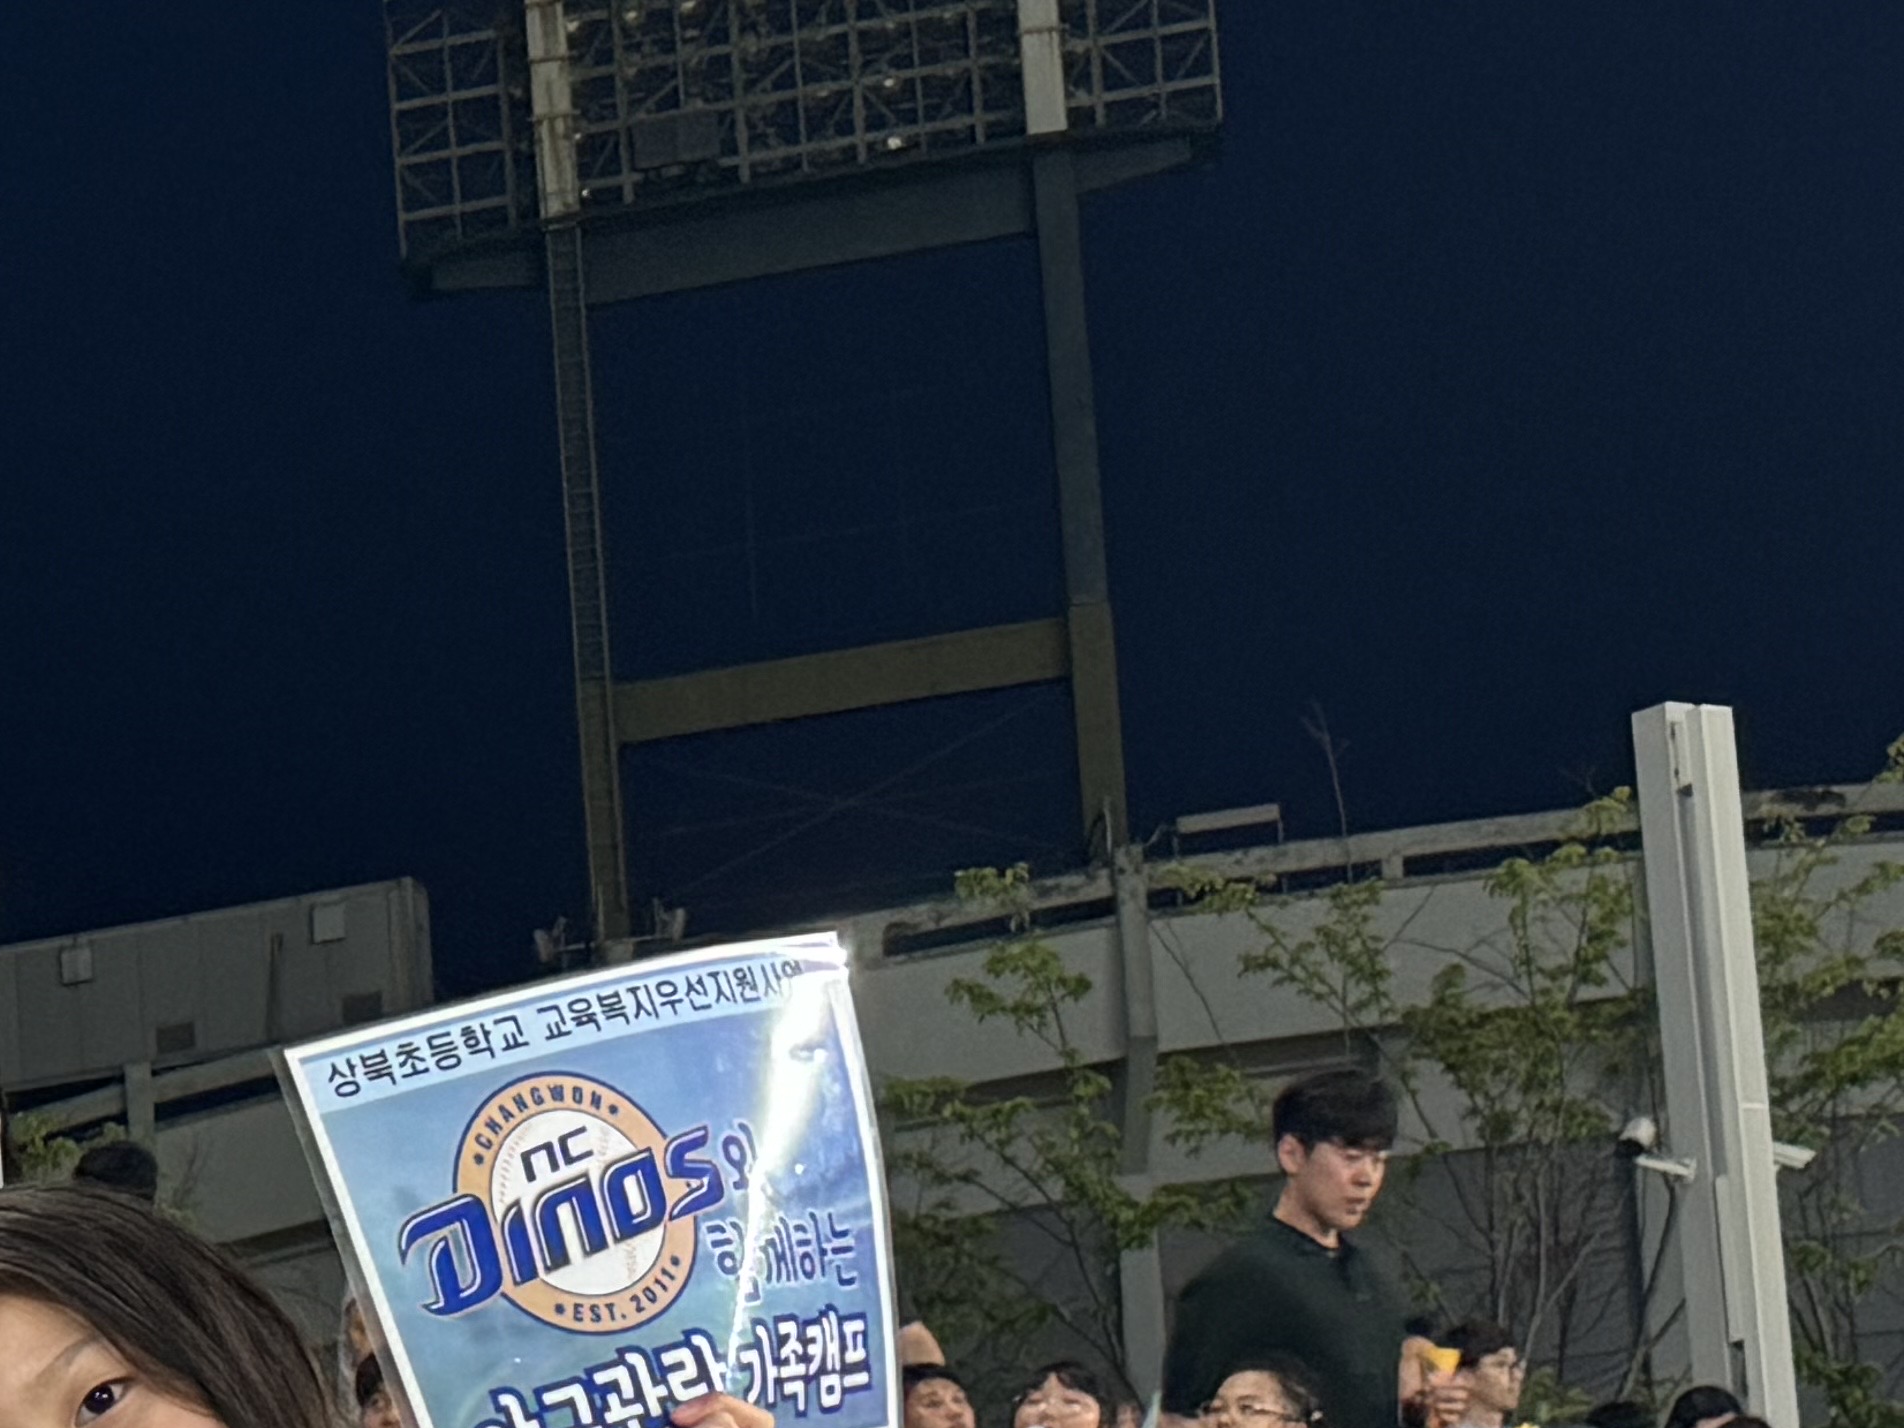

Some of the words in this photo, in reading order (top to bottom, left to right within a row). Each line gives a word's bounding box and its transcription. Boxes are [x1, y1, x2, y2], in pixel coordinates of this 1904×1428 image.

[327, 1016, 531, 1099] 상북초등학교
[474, 1083, 603, 1150] CHANGWON
[571, 1302, 628, 1323] EST.
[629, 1268, 677, 1314] 2011
[738, 1304, 873, 1418] 가족캠프
